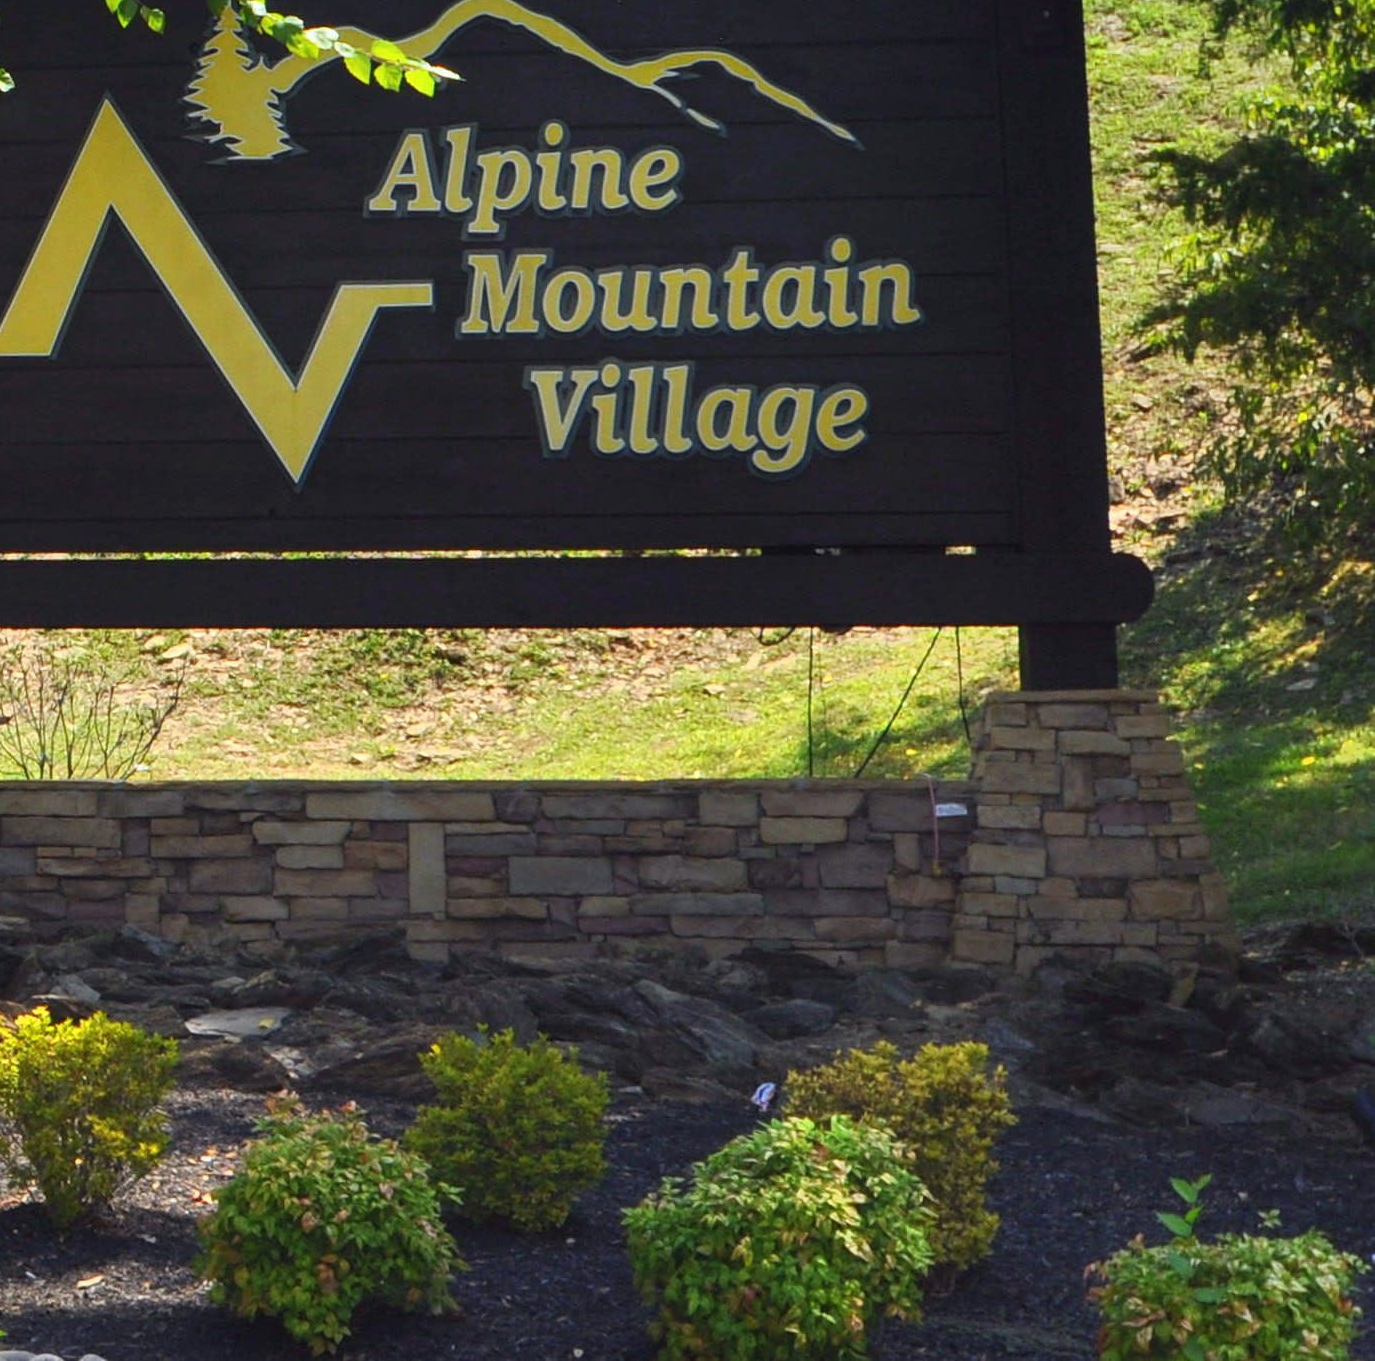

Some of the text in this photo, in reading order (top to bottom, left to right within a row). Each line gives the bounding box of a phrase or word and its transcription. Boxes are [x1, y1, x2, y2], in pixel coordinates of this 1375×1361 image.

[367, 122, 681, 235] Alpine
[459, 238, 921, 335] Mountain
[528, 362, 869, 474] Village
